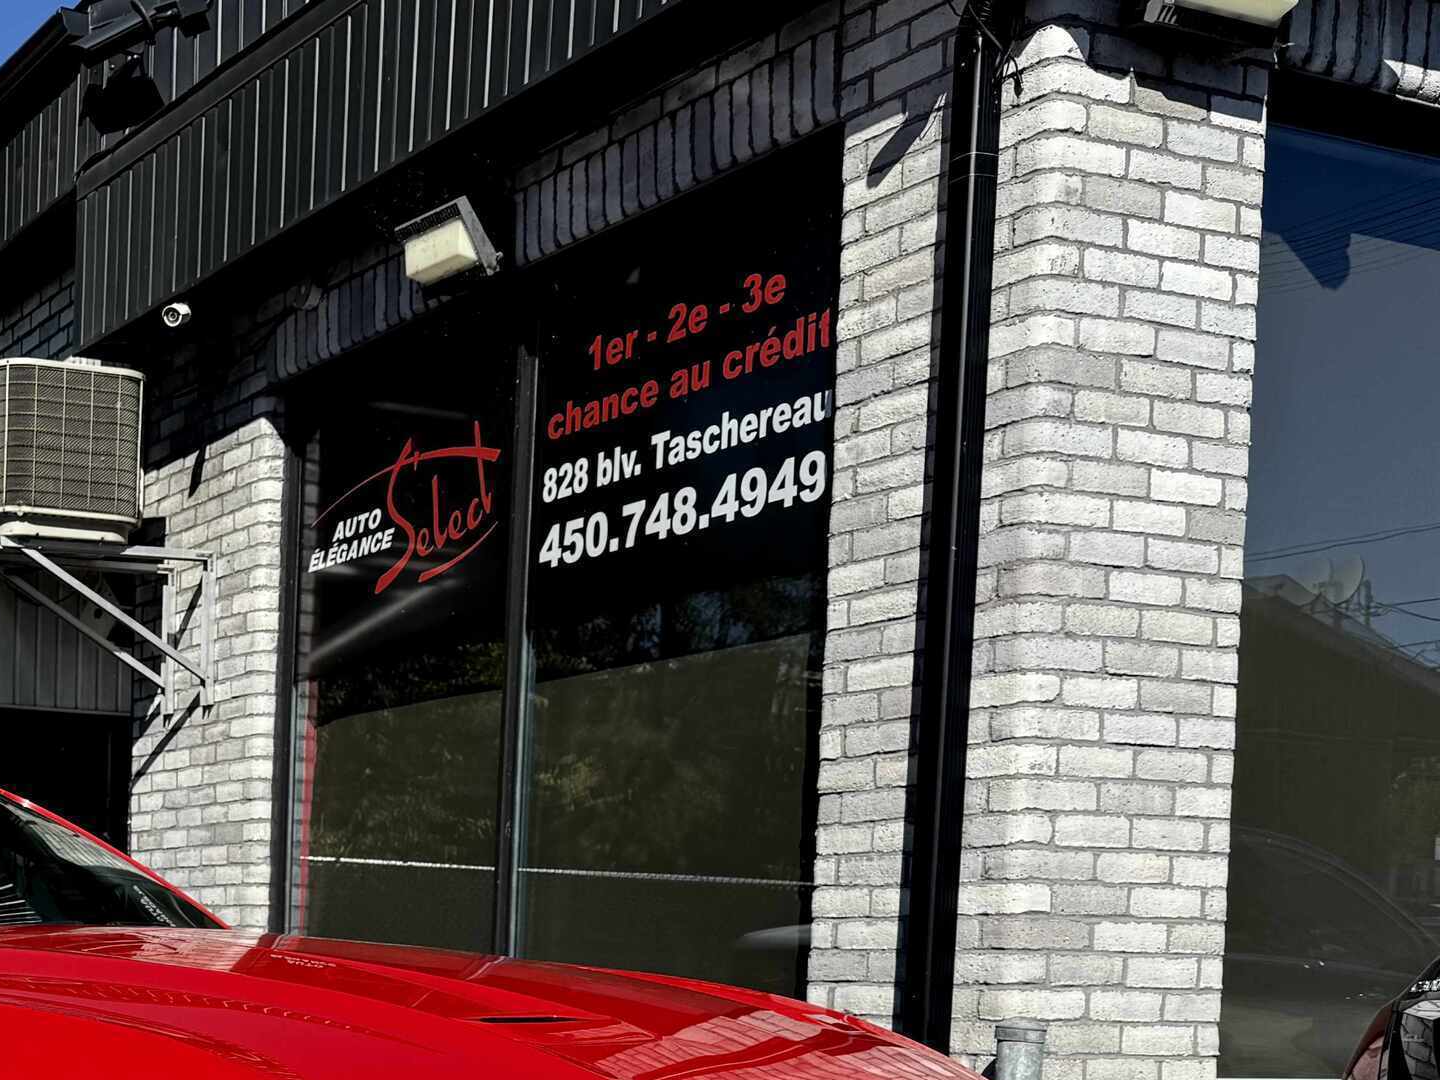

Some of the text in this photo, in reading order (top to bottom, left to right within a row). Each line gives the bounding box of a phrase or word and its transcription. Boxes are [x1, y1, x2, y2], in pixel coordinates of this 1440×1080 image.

[547, 308, 831, 440] chance au crédit
[588, 330, 638, 370] 1er
[666, 303, 708, 343] 2e
[741, 273, 786, 313] 3e
[542, 389, 832, 503] 828 blv. Taschereau
[308, 527, 396, 573] ÉLÉGANCE
[332, 508, 383, 543] AUTO
[374, 421, 501, 594] Select
[539, 450, 828, 568] 450.748.4949
